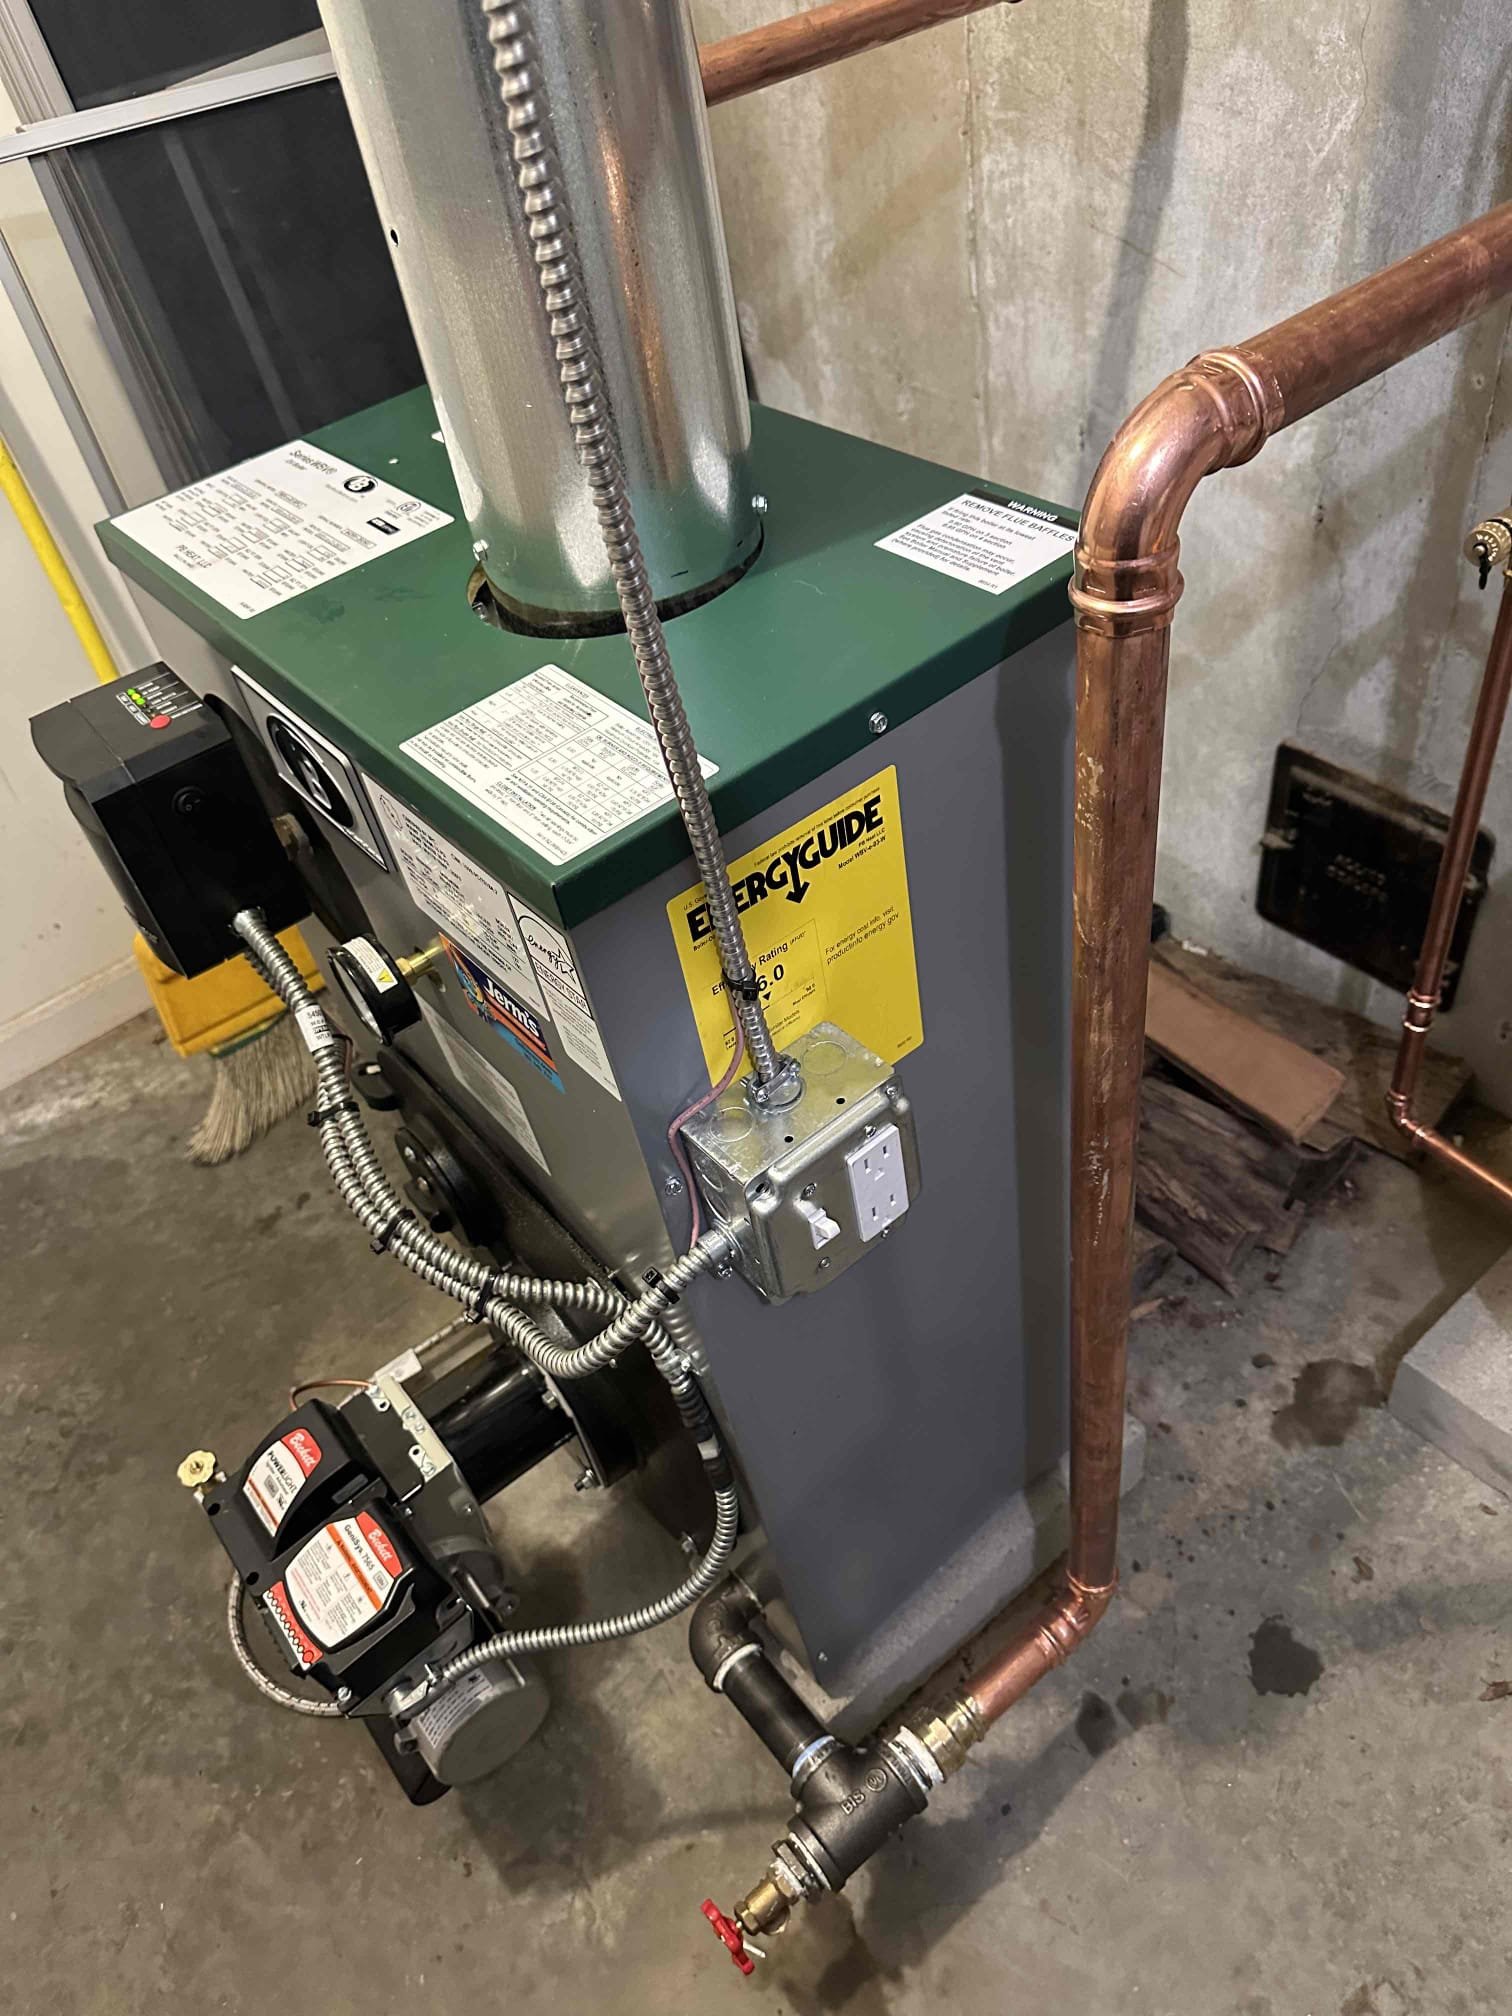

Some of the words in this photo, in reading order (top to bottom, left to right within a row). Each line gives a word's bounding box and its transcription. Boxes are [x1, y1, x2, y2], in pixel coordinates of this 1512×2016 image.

[961, 499, 1002, 516] REMOVE
[1002, 513, 1029, 525] FLUE
[1030, 522, 1075, 542] BAFFLES
[1007, 501, 1059, 522] WARNING
[942, 534, 982, 549] condensation
[981, 518, 998, 526] boiler
[1016, 530, 1035, 539] lowest
[984, 538, 1006, 548] section
[990, 534, 1012, 544] section
[904, 532, 926, 541] system
[938, 544, 968, 557] premature
[970, 556, 988, 564] failure
[934, 536, 972, 552] deterioration
[928, 546, 950, 555] Manual
[962, 560, 999, 576] Supplement
[838, 854, 855, 869] Model
[759, 941, 788, 965] Rating
[825, 943, 839, 956] For
[836, 930, 858, 950] energy
[857, 922, 873, 937] cost
[533, 959, 565, 992] ENERGY
[564, 985, 588, 1010] STAR
[756, 964, 784, 994] 6.0
[484, 977, 540, 1038] Jerm's
[289, 1431, 318, 1468] Beckett
[267, 1450, 298, 1494] POWERLIGHT
[344, 1524, 366, 1552] GeniSys
[362, 1549, 375, 1572] 7565
[368, 1530, 395, 1561] Beckett
